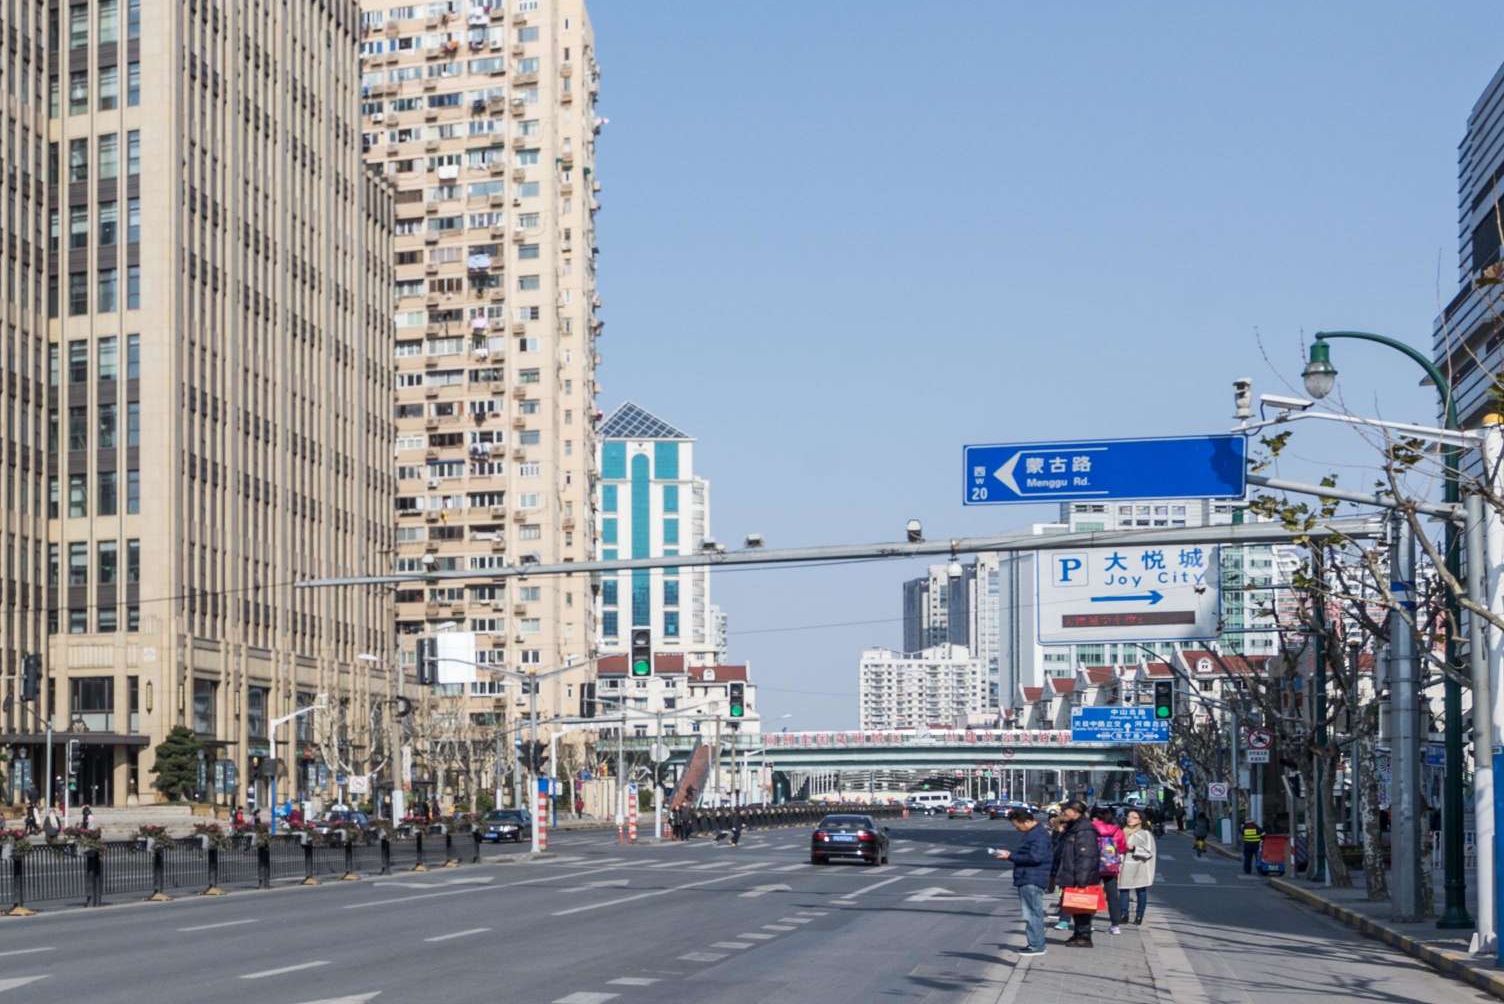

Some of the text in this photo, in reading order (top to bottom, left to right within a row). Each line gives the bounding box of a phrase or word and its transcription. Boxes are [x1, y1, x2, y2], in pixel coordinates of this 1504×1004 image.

[1025, 455, 1093, 474] 蒙古路
[1026, 477, 1092, 489] Menggu Rd.
[972, 487, 989, 500] 20
[1104, 548, 1204, 572] 大悦城
[1058, 558, 1082, 582] P
[1104, 571, 1204, 589] Joy City
